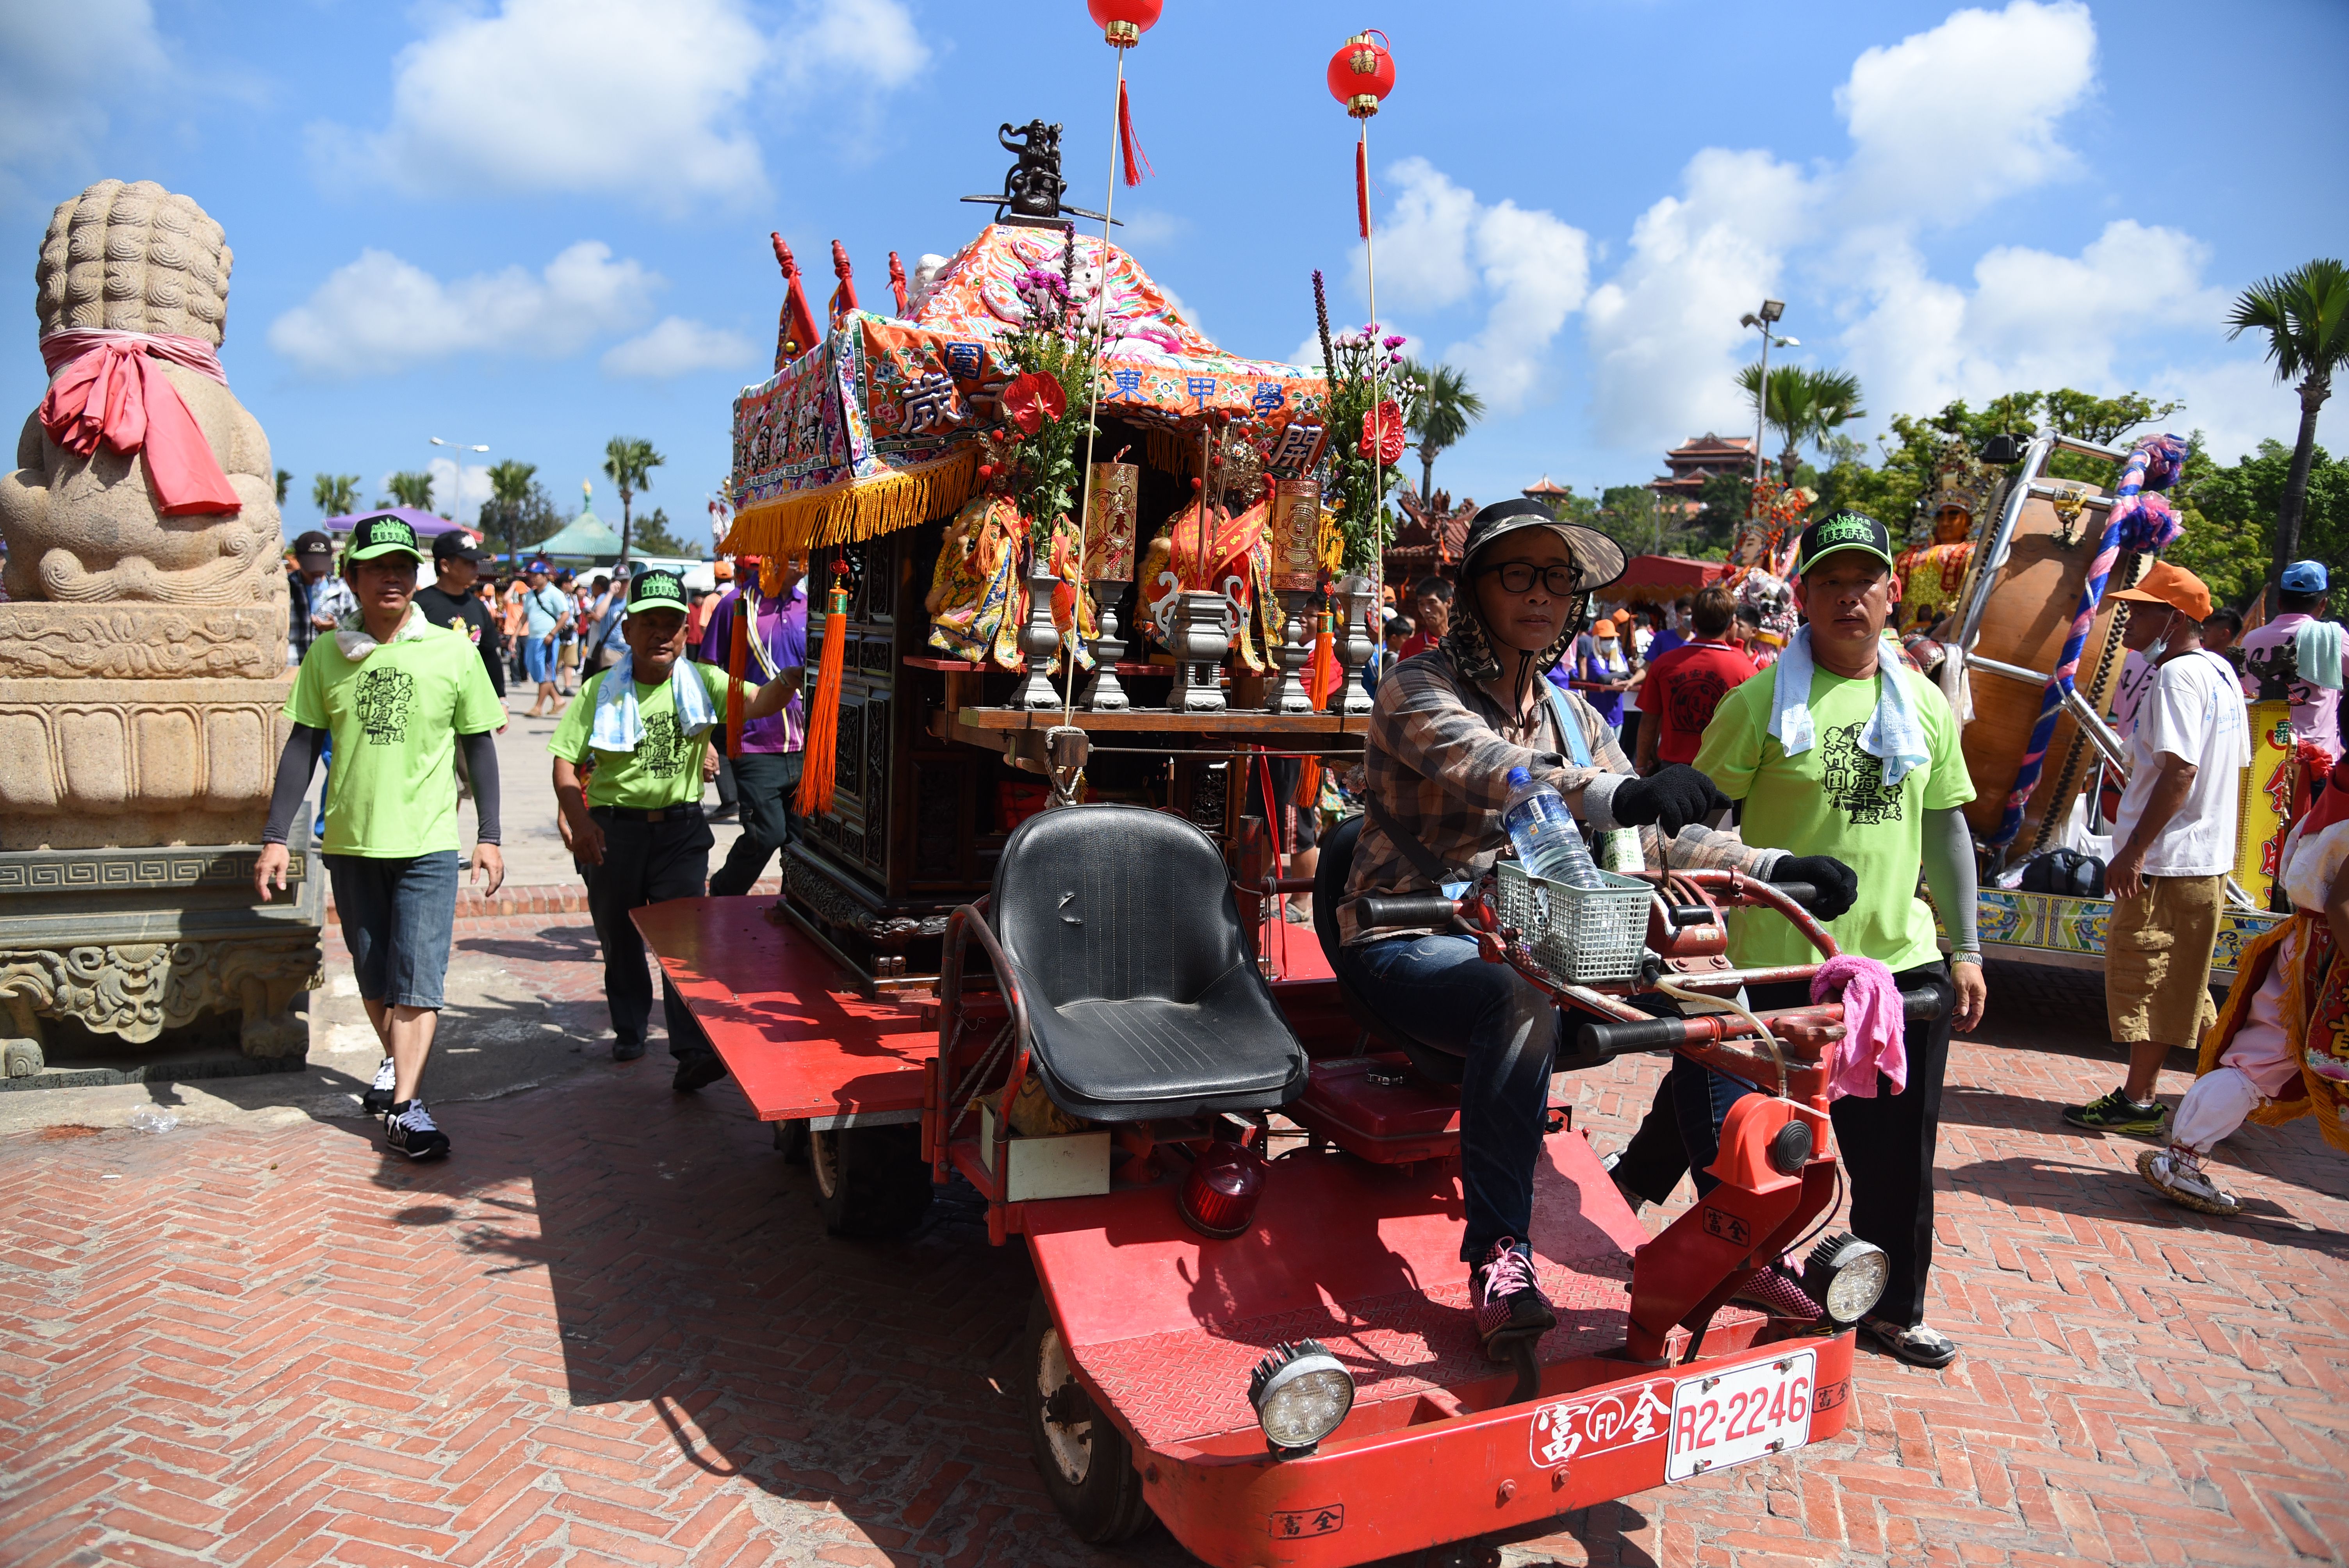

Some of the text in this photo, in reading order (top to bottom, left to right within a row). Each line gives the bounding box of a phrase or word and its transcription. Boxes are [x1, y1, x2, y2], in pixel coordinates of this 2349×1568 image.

[1348, 50, 1377, 75] 福
[1110, 511, 1131, 537] 春
[1823, 727, 1848, 791] 東竹圍
[1708, 1212, 1747, 1242] 富全
[1818, 1382, 1849, 1408] 富全
[1538, 1404, 1590, 1461] 富
[1622, 1383, 1672, 1441] 全
[1674, 1377, 1809, 1455] R2-2246
[1279, 1510, 1341, 1535] 富全
